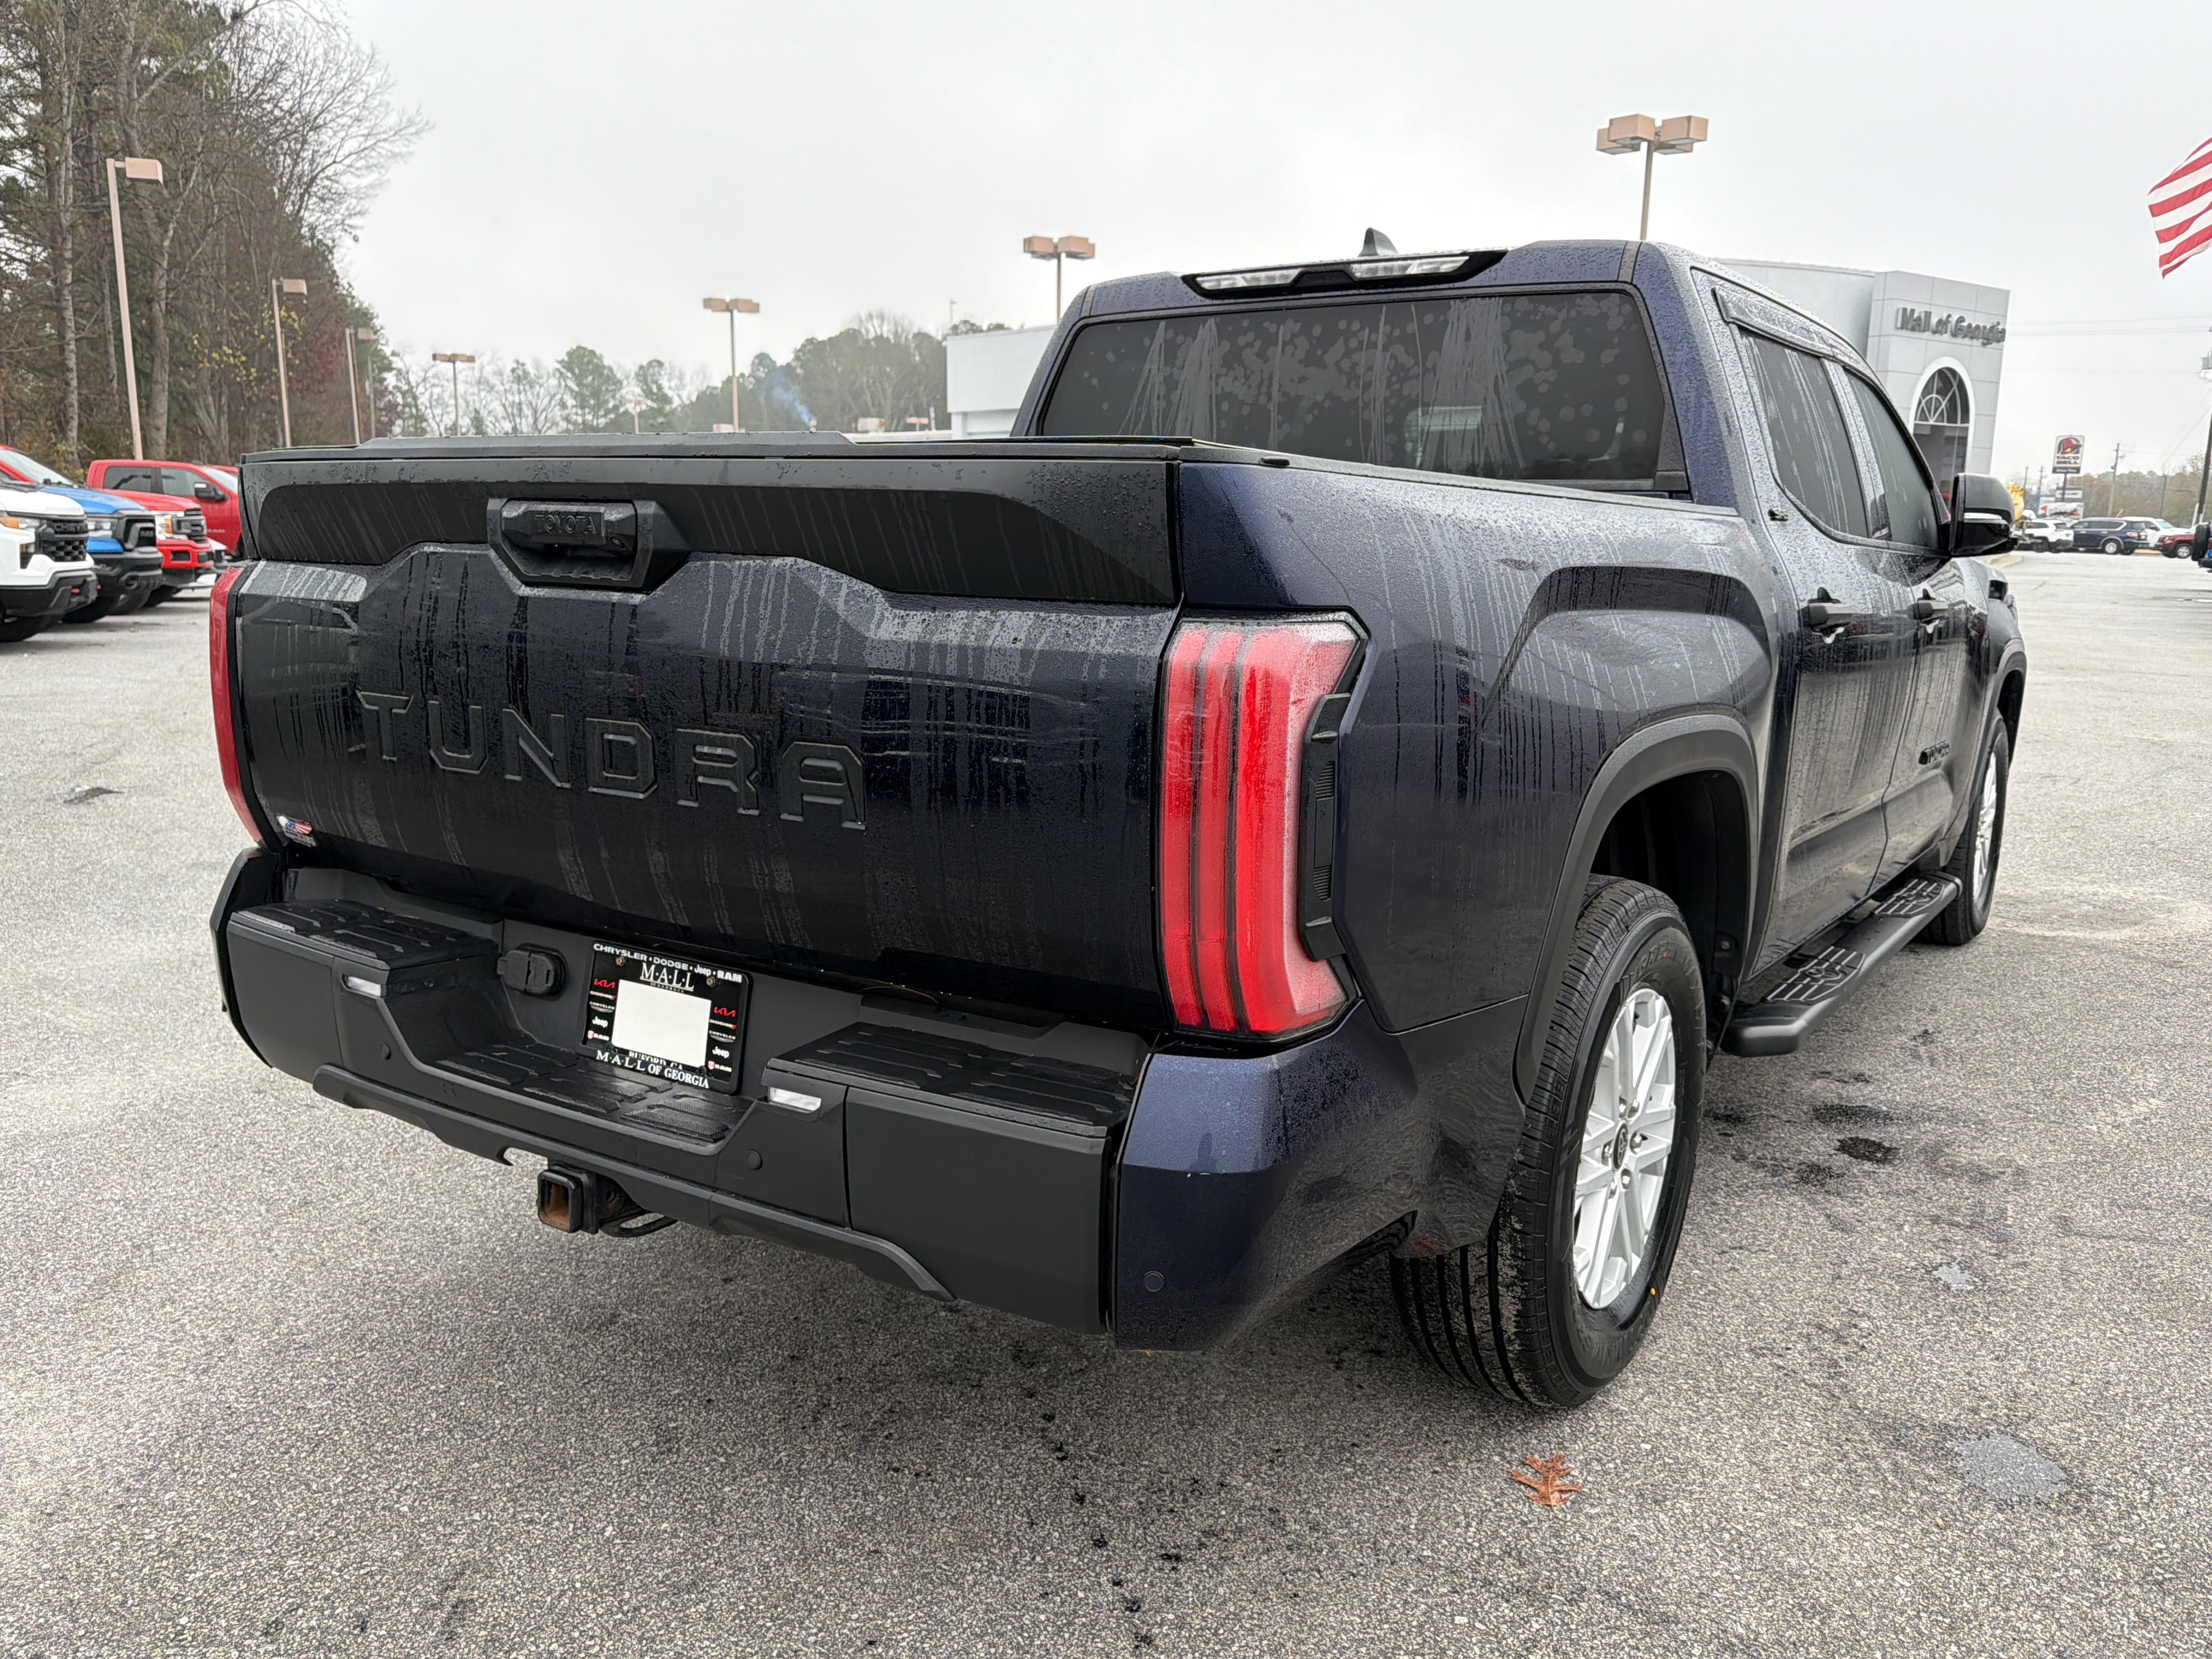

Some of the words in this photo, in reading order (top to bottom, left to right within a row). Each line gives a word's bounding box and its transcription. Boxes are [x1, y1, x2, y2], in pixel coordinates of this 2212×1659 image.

[1897, 307, 1932, 332] Mall
[1932, 313, 1951, 335] of
[1950, 315, 2006, 346] Georgia
[534, 514, 597, 535] TOYOTA
[356, 689, 868, 831] TUNDRA
[593, 943, 647, 962] CHRYSLER
[653, 956, 689, 971] DODGE
[694, 964, 712, 977] Jeep
[716, 969, 743, 984] RAM
[593, 978, 616, 989] KIA
[589, 990, 614, 1000] DODGE
[589, 1001, 615, 1010] CHRYSLER
[714, 1006, 736, 1018] KIA
[592, 1015, 608, 1028] Jeep
[709, 1019, 734, 1028] DODGE
[593, 1032, 610, 1041] RAM
[709, 1030, 736, 1040] CHRYSLER
[712, 1046, 730, 1059] Jeep
[714, 1063, 732, 1073] RAM
[647, 1063, 663, 1076] OF
[664, 1068, 709, 1089] GEORGIA
